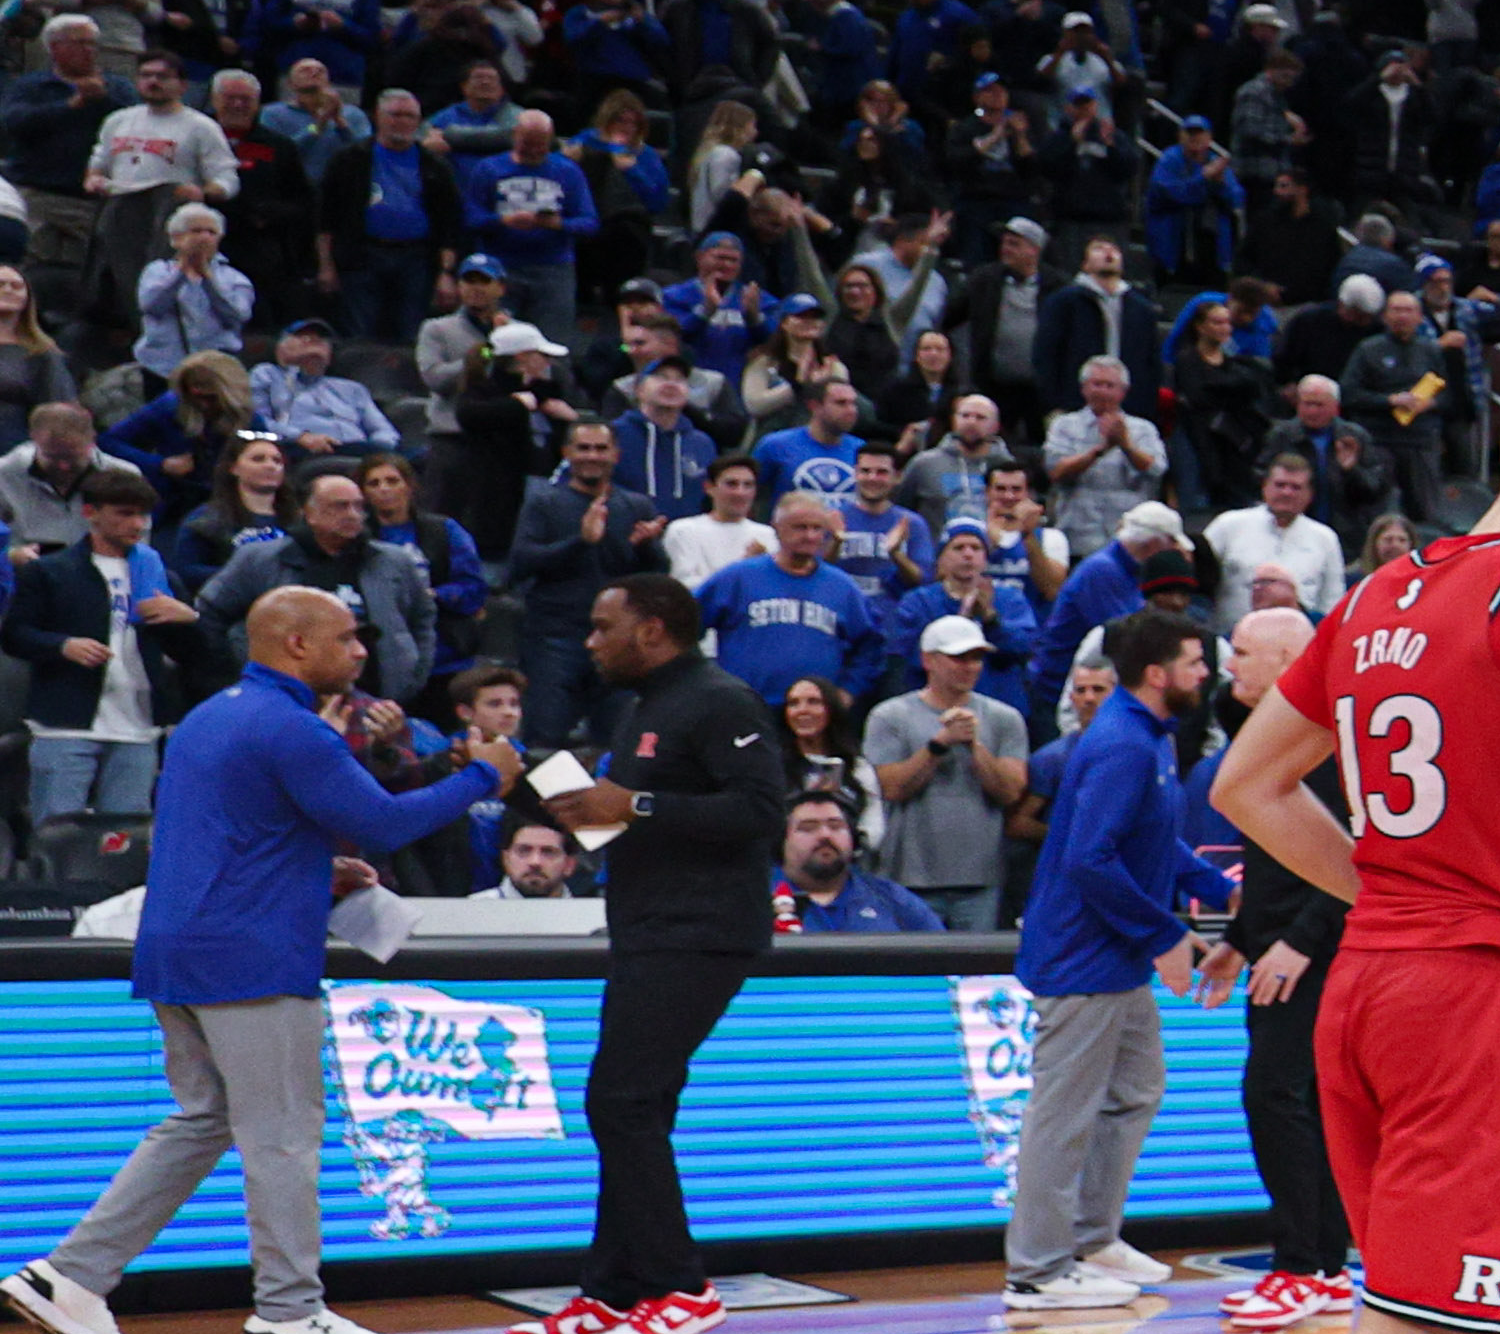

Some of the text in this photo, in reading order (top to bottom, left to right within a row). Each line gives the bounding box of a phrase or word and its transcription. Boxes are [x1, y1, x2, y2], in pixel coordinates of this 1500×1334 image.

[747, 599, 799, 628] SETON
[1352, 627, 1429, 675] ZRNO
[1335, 693, 1448, 839] 13
[404, 1005, 475, 1068] We
[364, 1051, 471, 1101] Own
